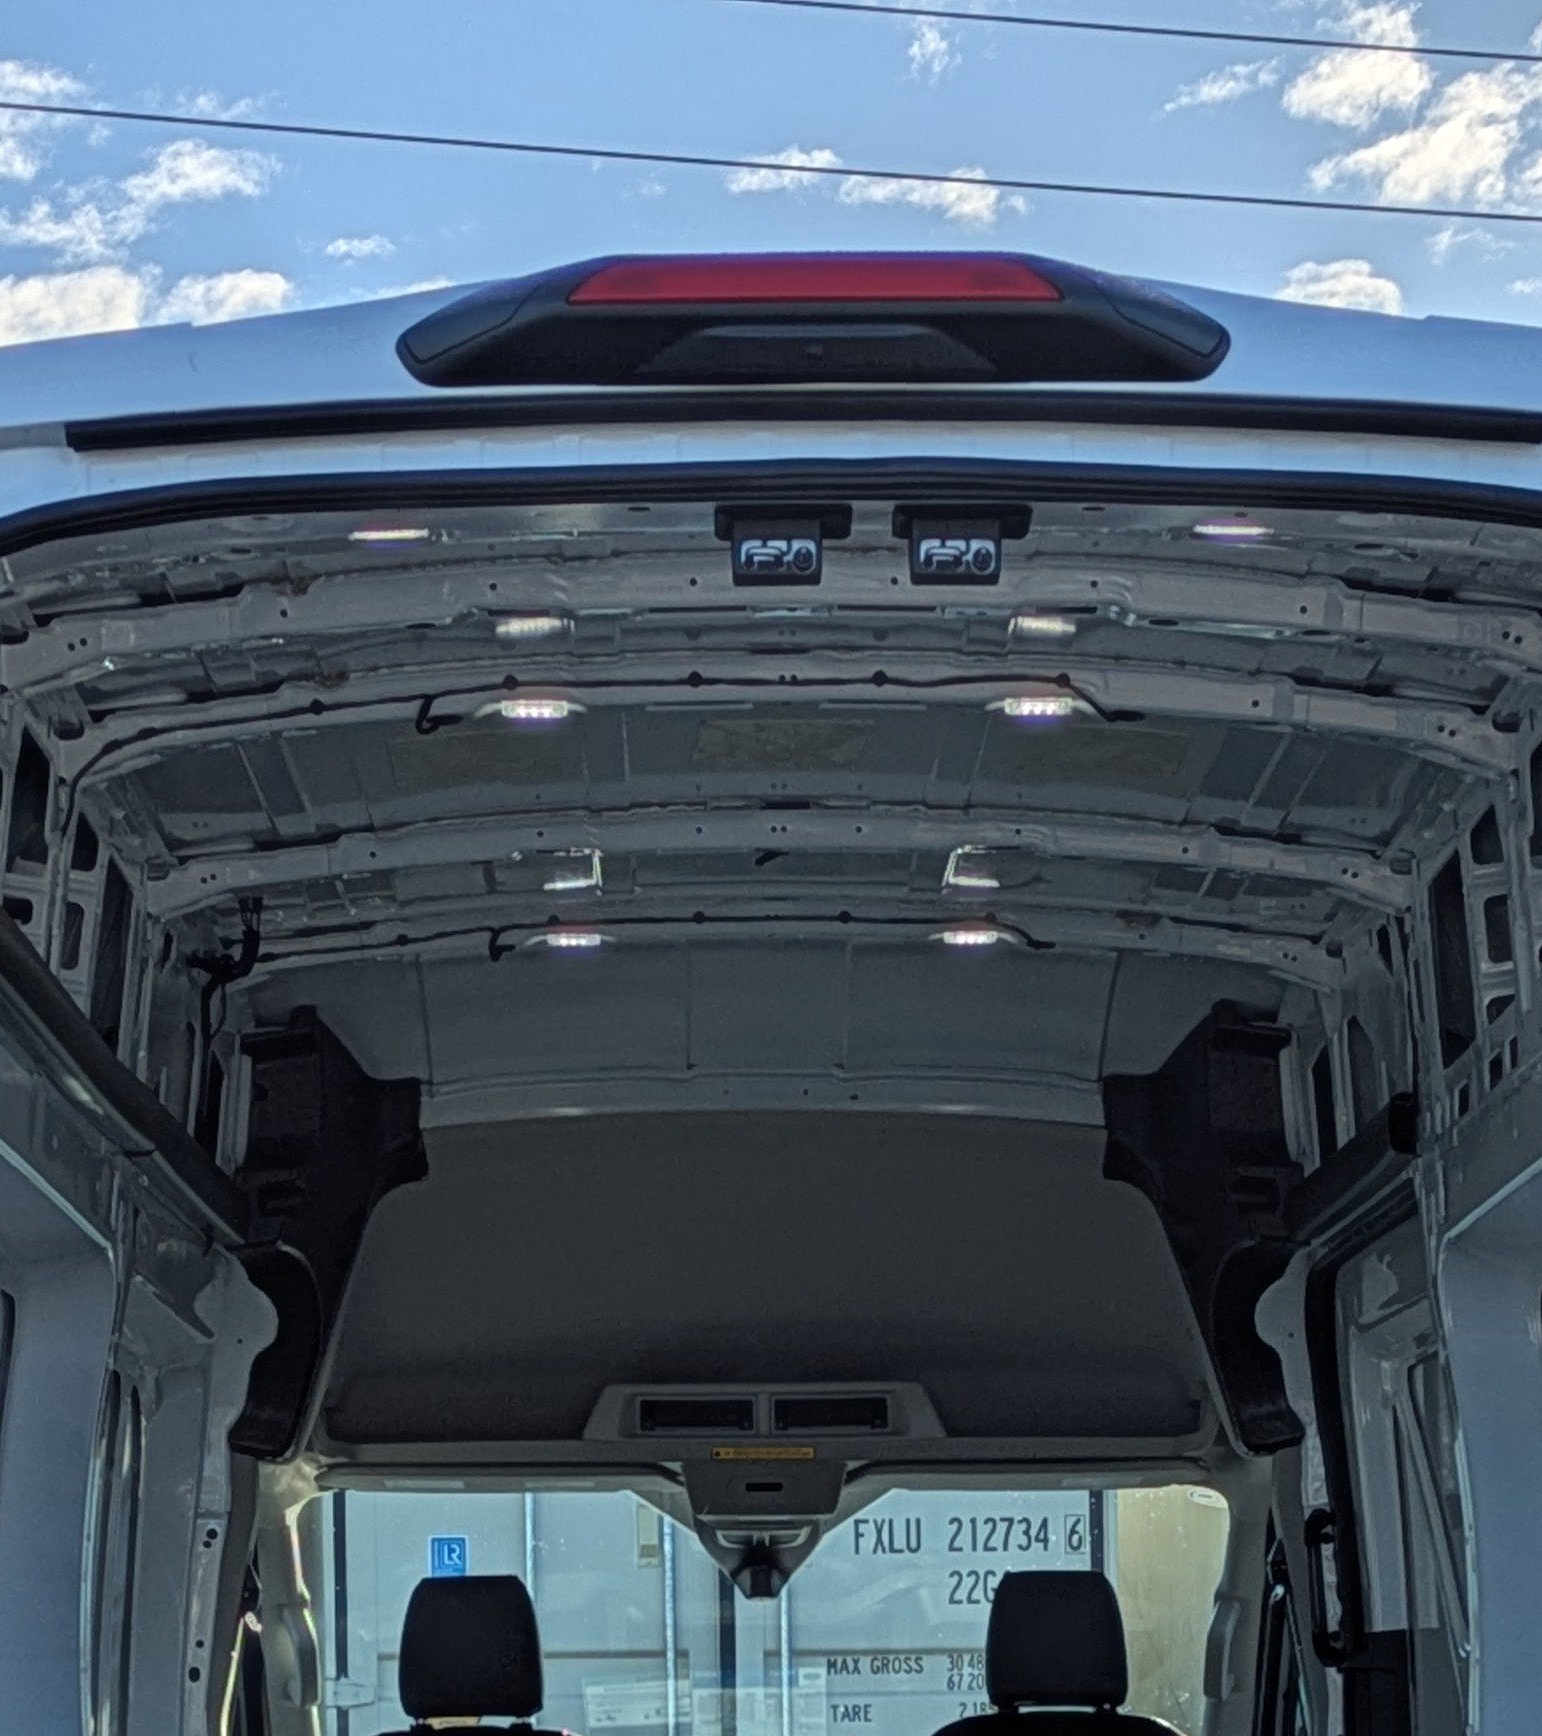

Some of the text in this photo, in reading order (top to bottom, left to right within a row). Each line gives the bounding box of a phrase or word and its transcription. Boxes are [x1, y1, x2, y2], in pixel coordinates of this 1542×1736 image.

[853, 1516, 1084, 1555] FXLU 212734 6
[826, 1657, 861, 1676] MAX
[870, 1656, 924, 1675] GROSS
[830, 1703, 873, 1723] TARE
